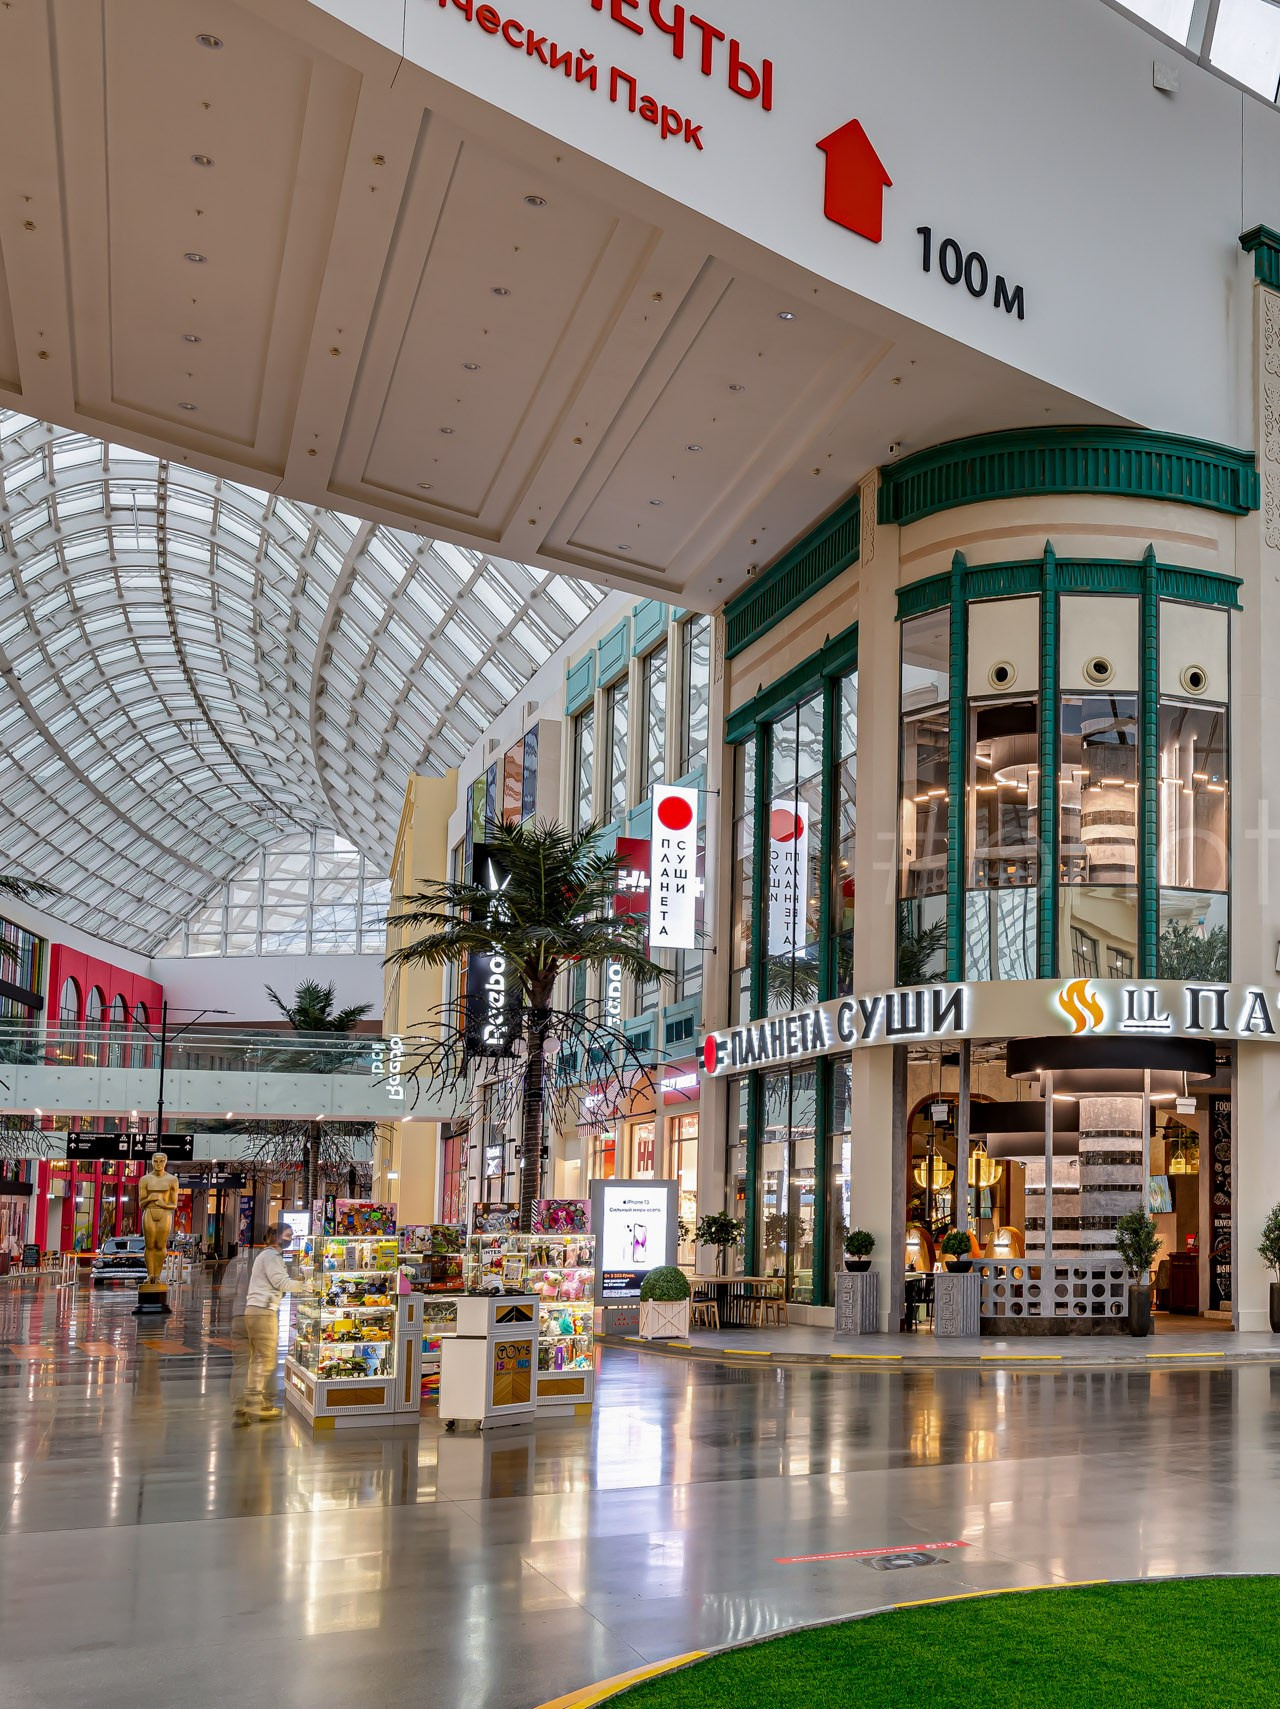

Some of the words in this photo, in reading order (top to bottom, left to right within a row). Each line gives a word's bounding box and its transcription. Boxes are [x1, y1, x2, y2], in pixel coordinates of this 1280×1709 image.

[438, 0, 598, 91] ческий
[609, 66, 704, 151] Парк
[591, 0, 773, 112] ЕЧТЫ
[658, 838, 671, 936] ПЛАНЕТА
[674, 840, 688, 894] СУШИ
[731, 1010, 828, 1067] ПЛАНЕТА
[837, 986, 966, 1043] СУШИ
[1123, 988, 1171, 1028] IL
